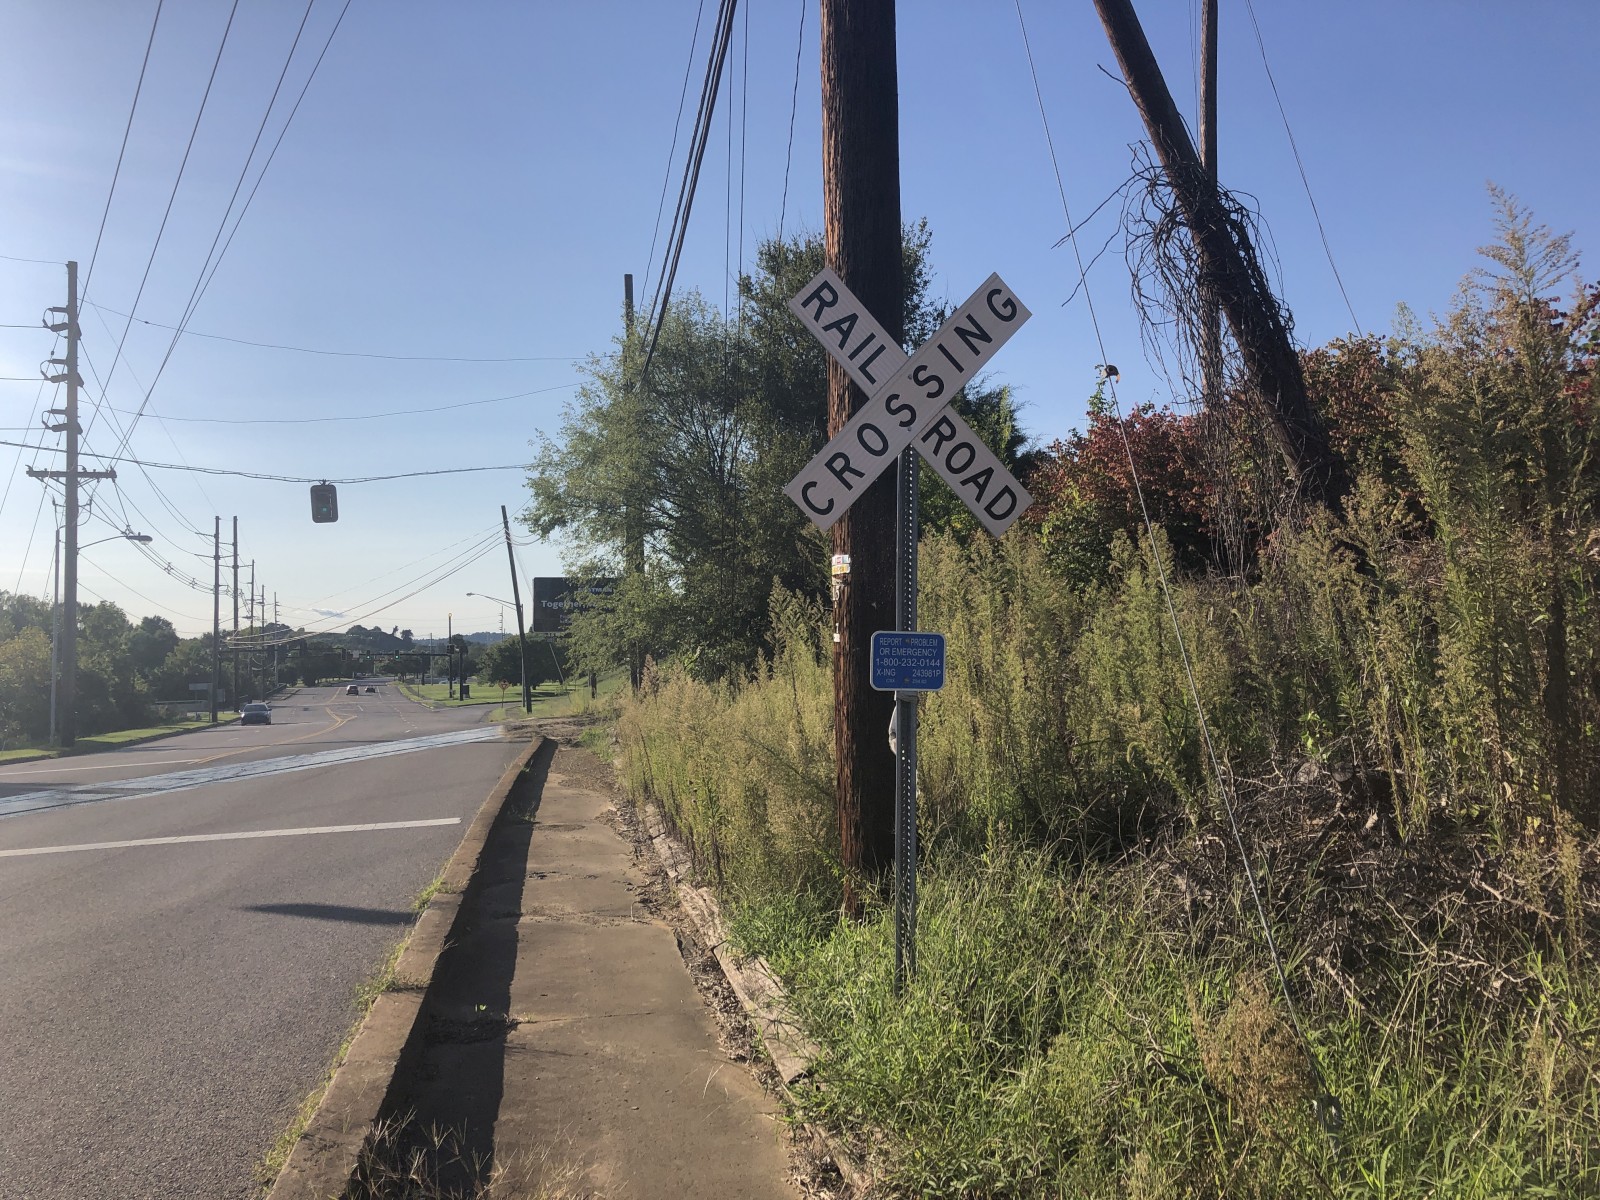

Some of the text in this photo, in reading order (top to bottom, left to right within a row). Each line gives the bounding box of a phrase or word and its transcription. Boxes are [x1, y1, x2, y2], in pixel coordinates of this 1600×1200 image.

[801, 280, 1018, 521] RAIL ROAD
[801, 288, 1018, 516] CROSSING
[880, 638, 938, 647] REPORT PROBLEM
[880, 648, 937, 657] OR EMERGENCY
[876, 658, 940, 667] 1-800-232-0144
[877, 669, 896, 677] X-ING
